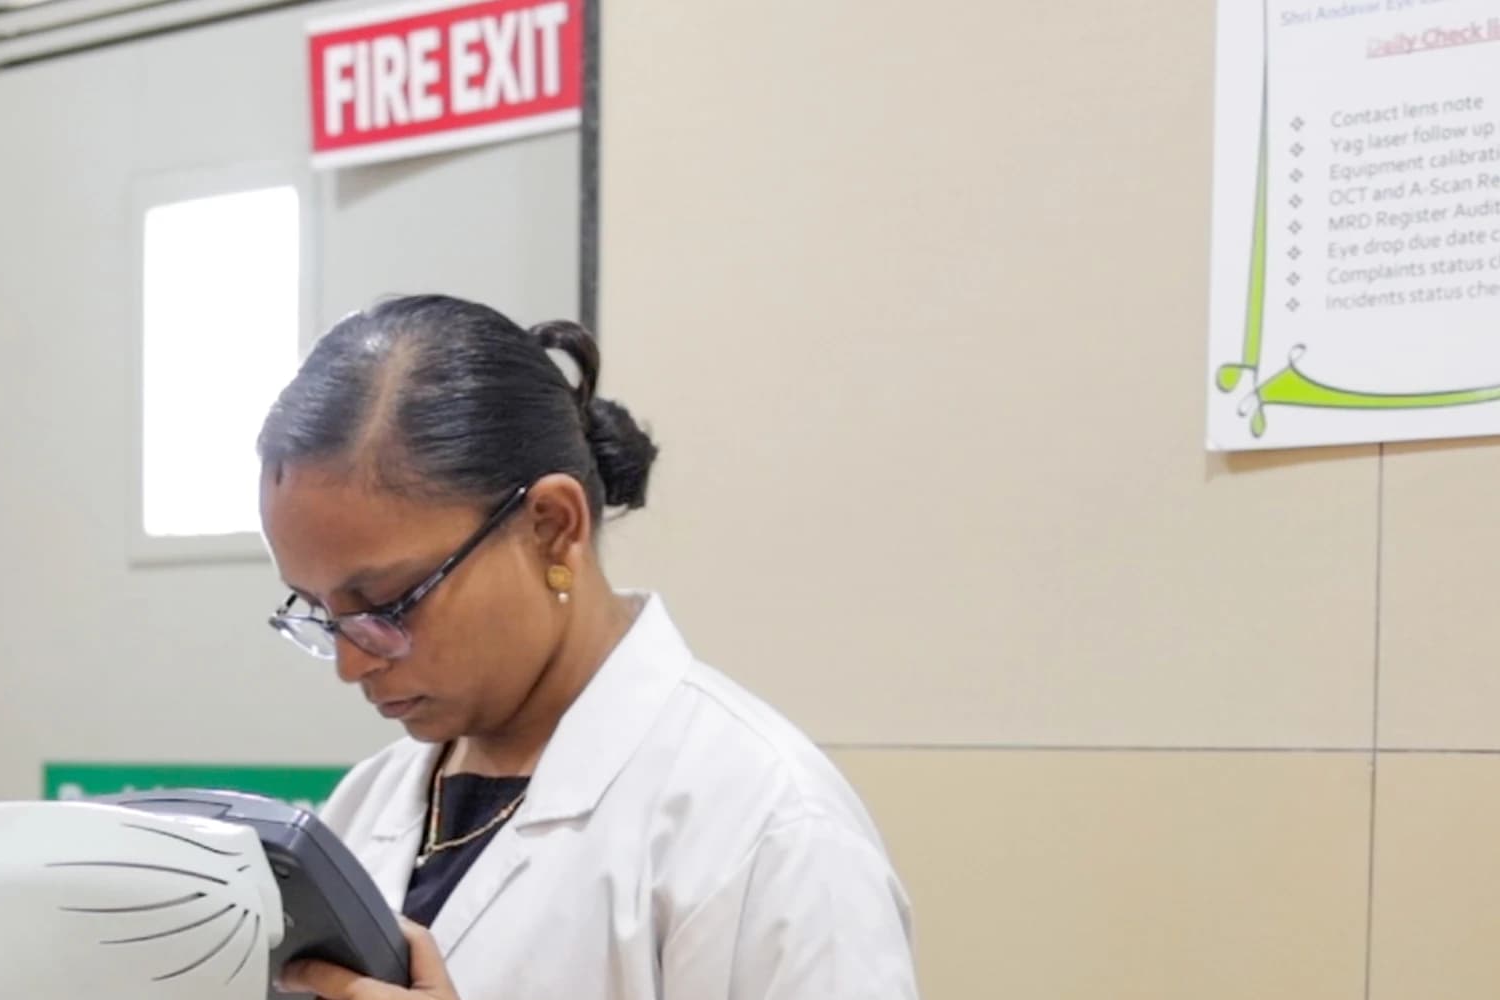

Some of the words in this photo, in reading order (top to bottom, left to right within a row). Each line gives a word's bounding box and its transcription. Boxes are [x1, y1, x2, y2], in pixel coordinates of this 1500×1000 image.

[1280, 9, 1312, 26] Shri
[1364, 31, 1416, 57] Daily
[1422, 21, 1484, 49] Check
[323, 26, 444, 136] FIRE
[450, 1, 569, 115] EXIT
[1330, 106, 1398, 128] Contact
[1403, 99, 1439, 118] lens
[1443, 96, 1484, 112] note
[1330, 137, 1364, 156] Yag
[1368, 132, 1407, 150] laser
[1413, 125, 1468, 145] follow
[1472, 121, 1495, 138] up
[1329, 155, 1424, 181] Equipment
[1329, 187, 1368, 206] OCT
[1372, 183, 1405, 202] and
[1410, 177, 1473, 197] A-Scan
[1328, 213, 1372, 231] MRD
[1376, 207, 1448, 230] Register
[1327, 242, 1360, 260] Eye
[1364, 237, 1405, 256] drop
[1408, 232, 1442, 250] due
[1446, 229, 1487, 246] date
[1327, 262, 1426, 285] Complaints
[1430, 257, 1485, 275] status
[1326, 289, 1405, 311] Incidents
[1409, 285, 1464, 304] status
